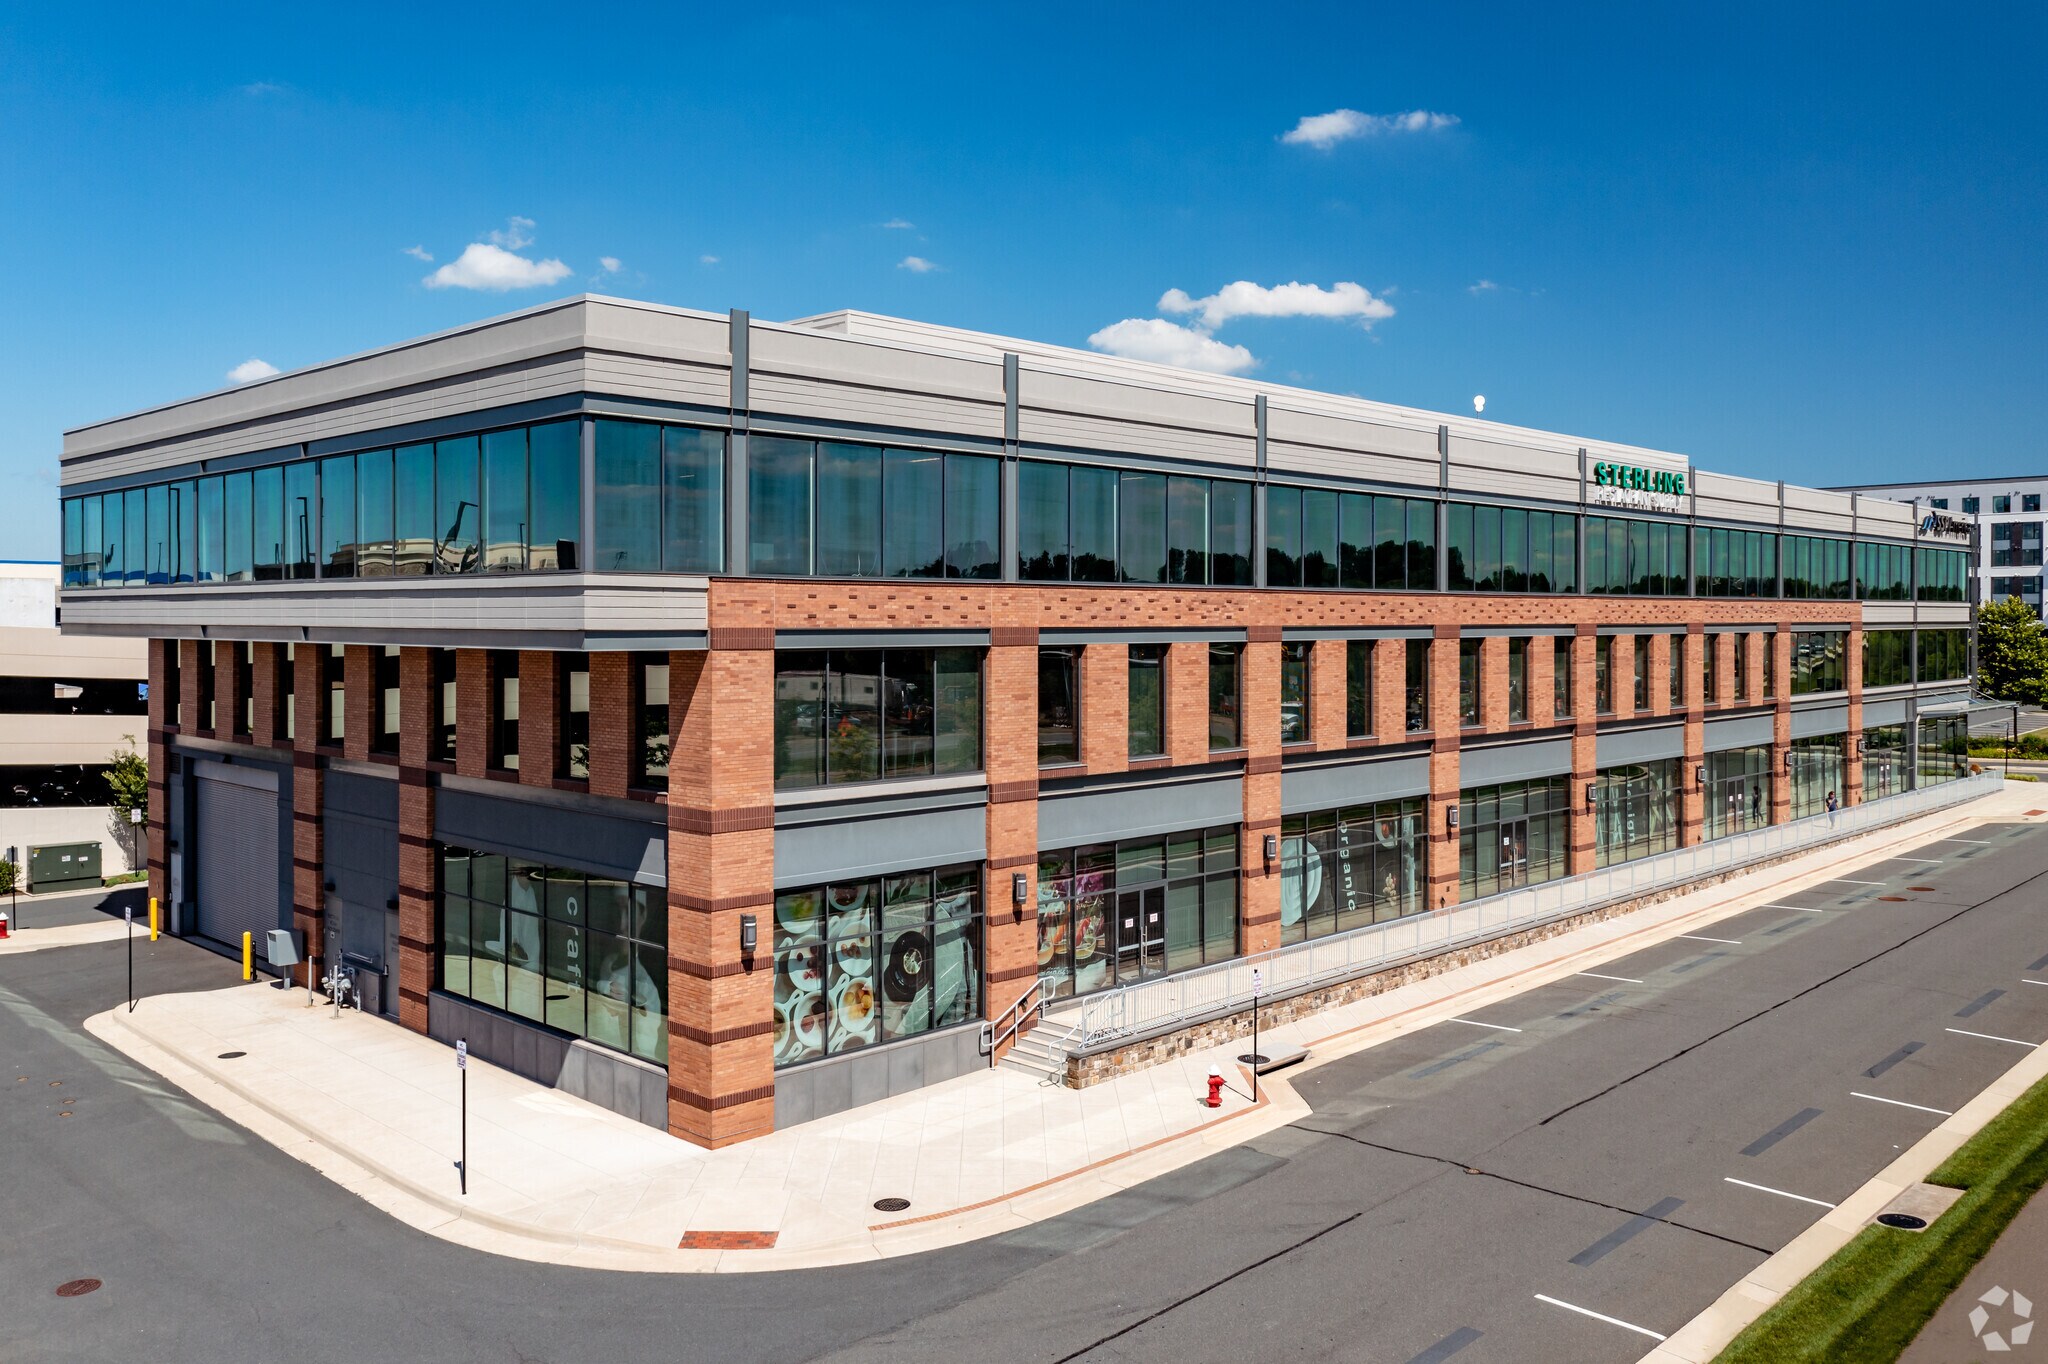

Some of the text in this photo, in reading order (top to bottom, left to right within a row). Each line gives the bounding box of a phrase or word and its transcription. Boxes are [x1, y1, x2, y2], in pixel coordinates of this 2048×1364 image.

[1594, 461, 1685, 495] STERLING
[1340, 821, 1356, 911] organic
[566, 896, 582, 993] craft
